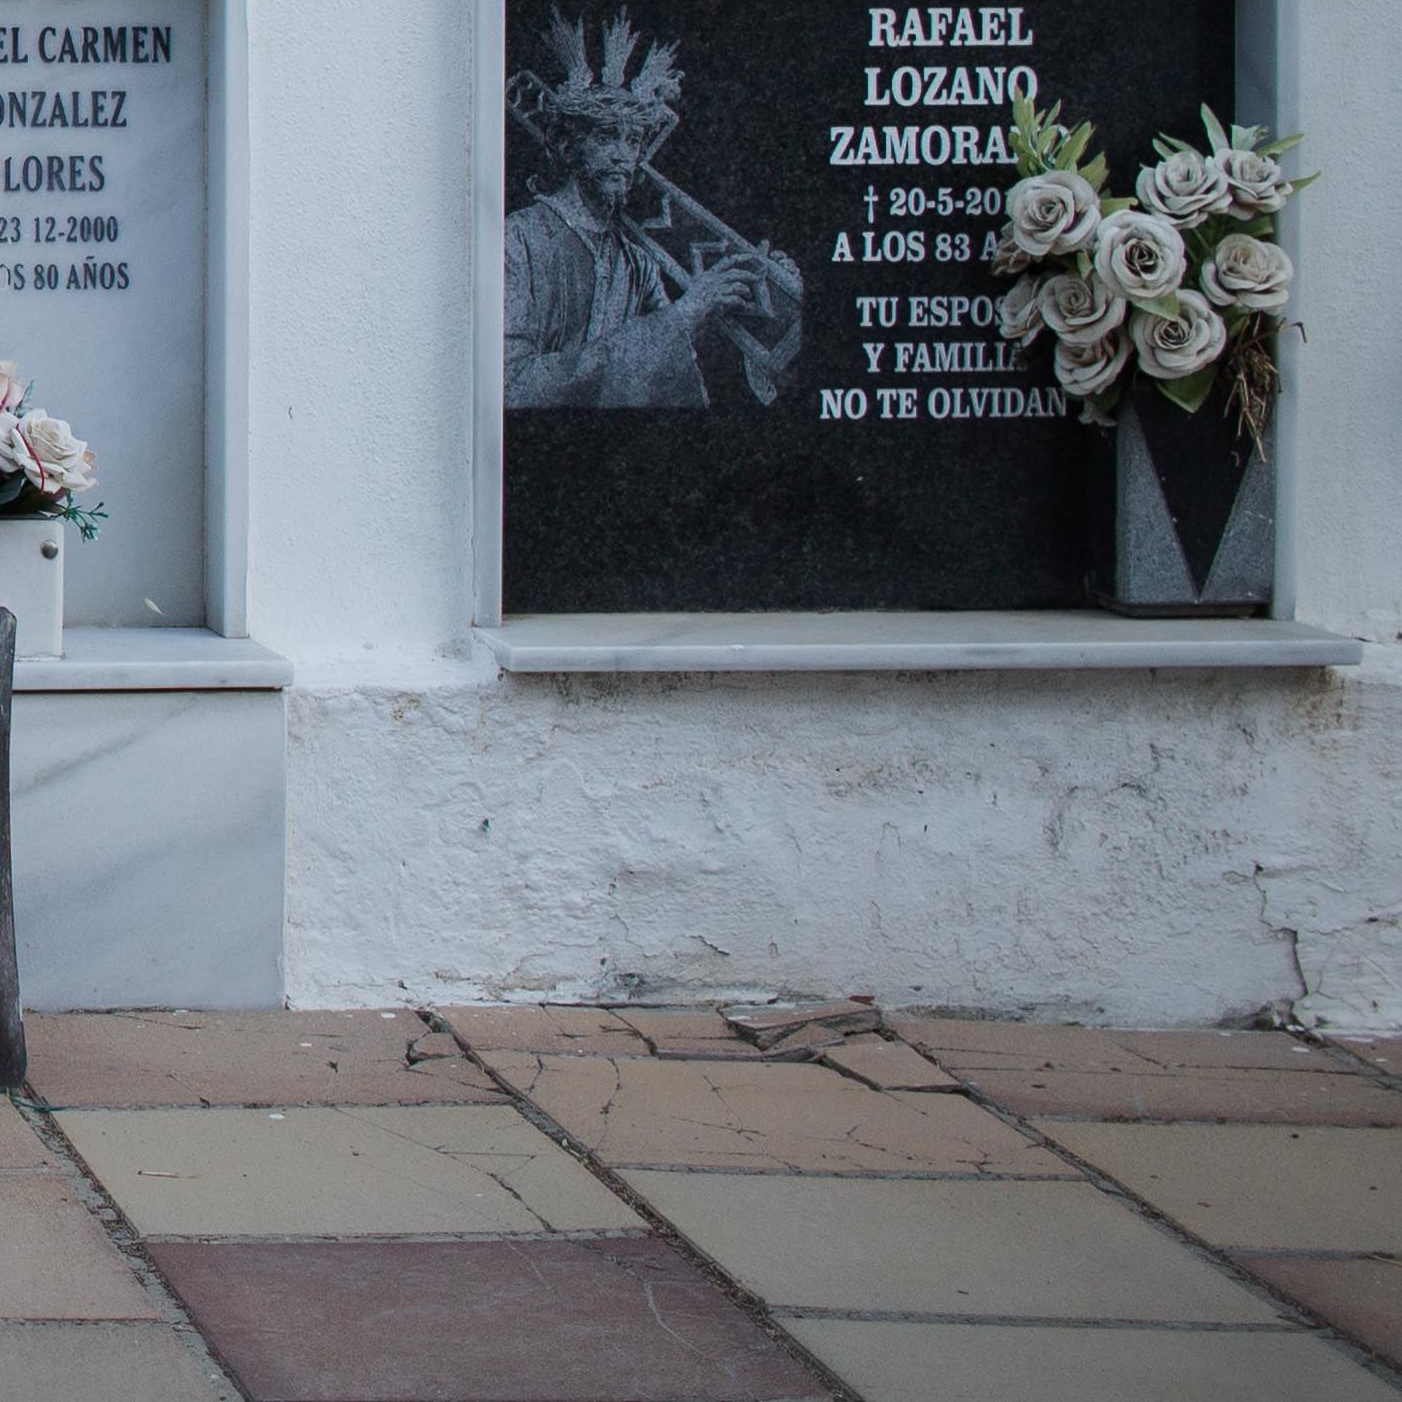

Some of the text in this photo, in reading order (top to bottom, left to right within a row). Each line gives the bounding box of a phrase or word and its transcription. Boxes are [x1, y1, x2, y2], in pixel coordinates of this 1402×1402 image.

[38, 24, 172, 64] CARMEN
[868, 7, 1034, 48] RAFAEL
[864, 66, 1038, 107] LOZANO
[831, 231, 855, 262] A
[861, 230, 926, 263] LOS
[934, 233, 971, 262] 83
[33, 263, 59, 291] 80
[65, 255, 130, 291] AÑOS
[855, 296, 900, 328] TU
[862, 342, 885, 373] Y
[819, 388, 1067, 420] NO TE OLVIDAN
